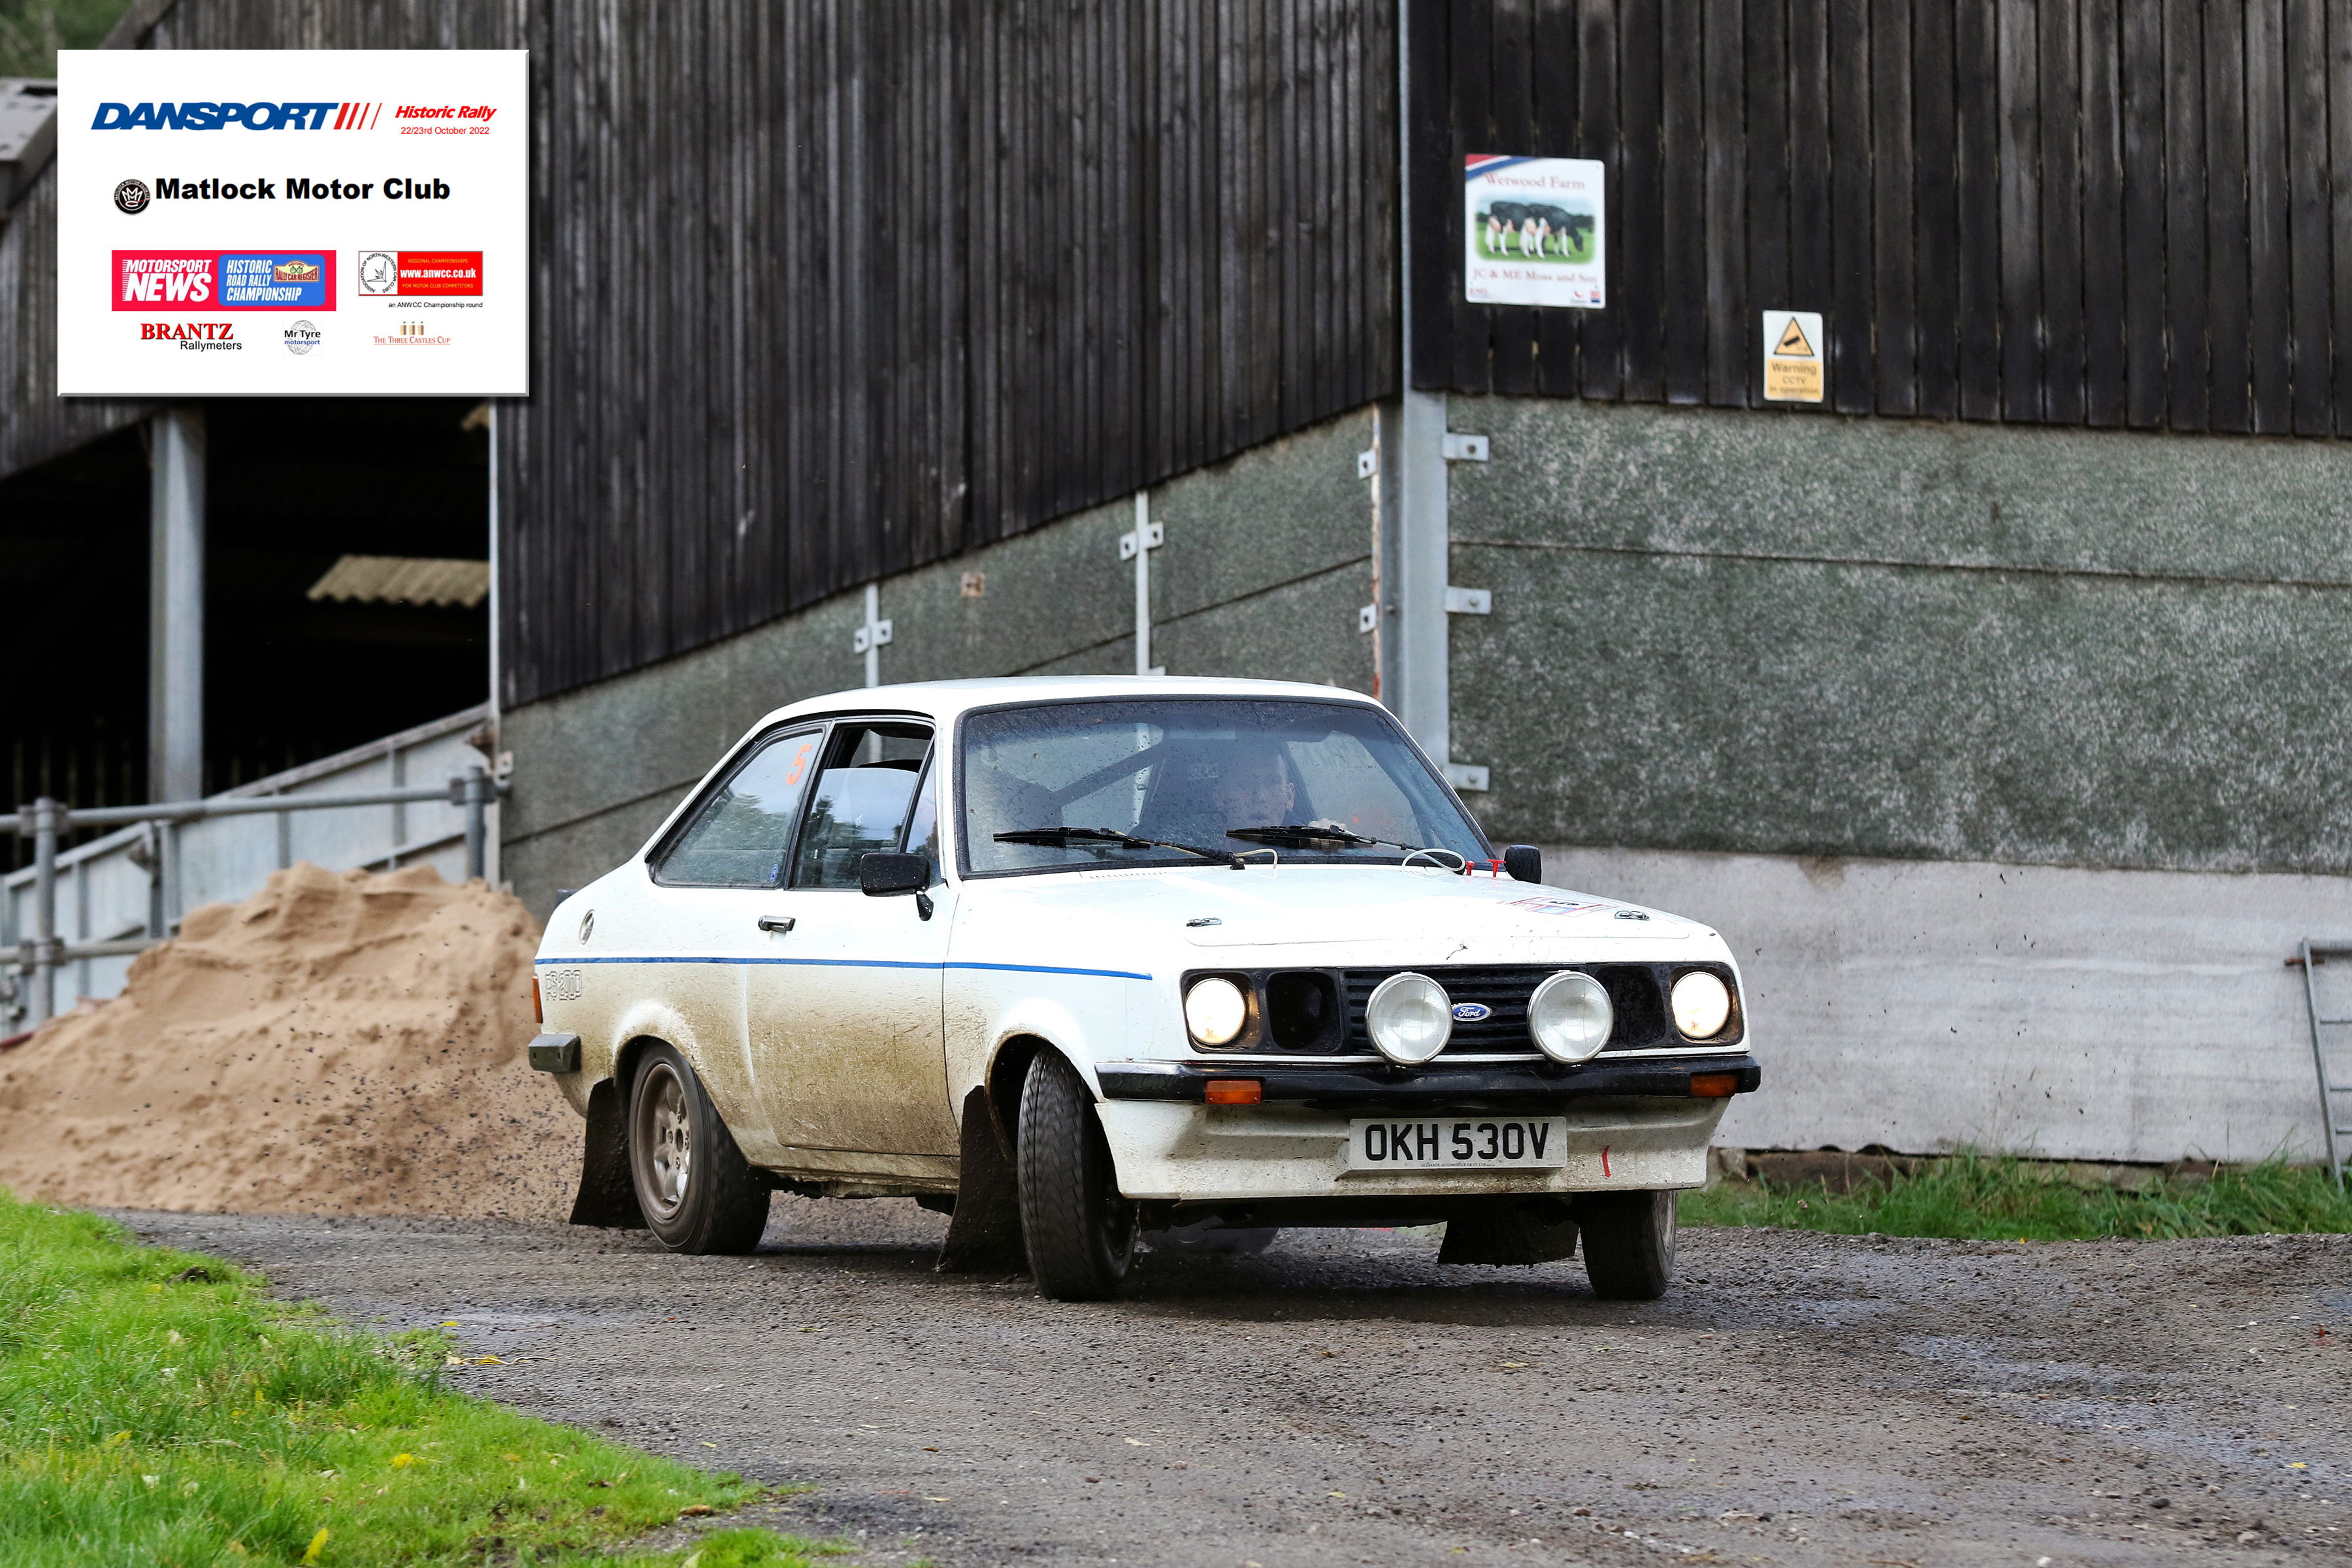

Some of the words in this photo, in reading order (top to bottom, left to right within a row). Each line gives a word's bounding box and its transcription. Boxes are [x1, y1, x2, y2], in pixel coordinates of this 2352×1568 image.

[1550, 176, 1585, 189] Farm
[1772, 362, 1817, 376] Warning
[786, 744, 813, 785] 5
[1458, 1007, 1481, 1017] Ford
[1365, 1123, 1439, 1161] OKH
[1451, 1122, 1550, 1161] 530V
